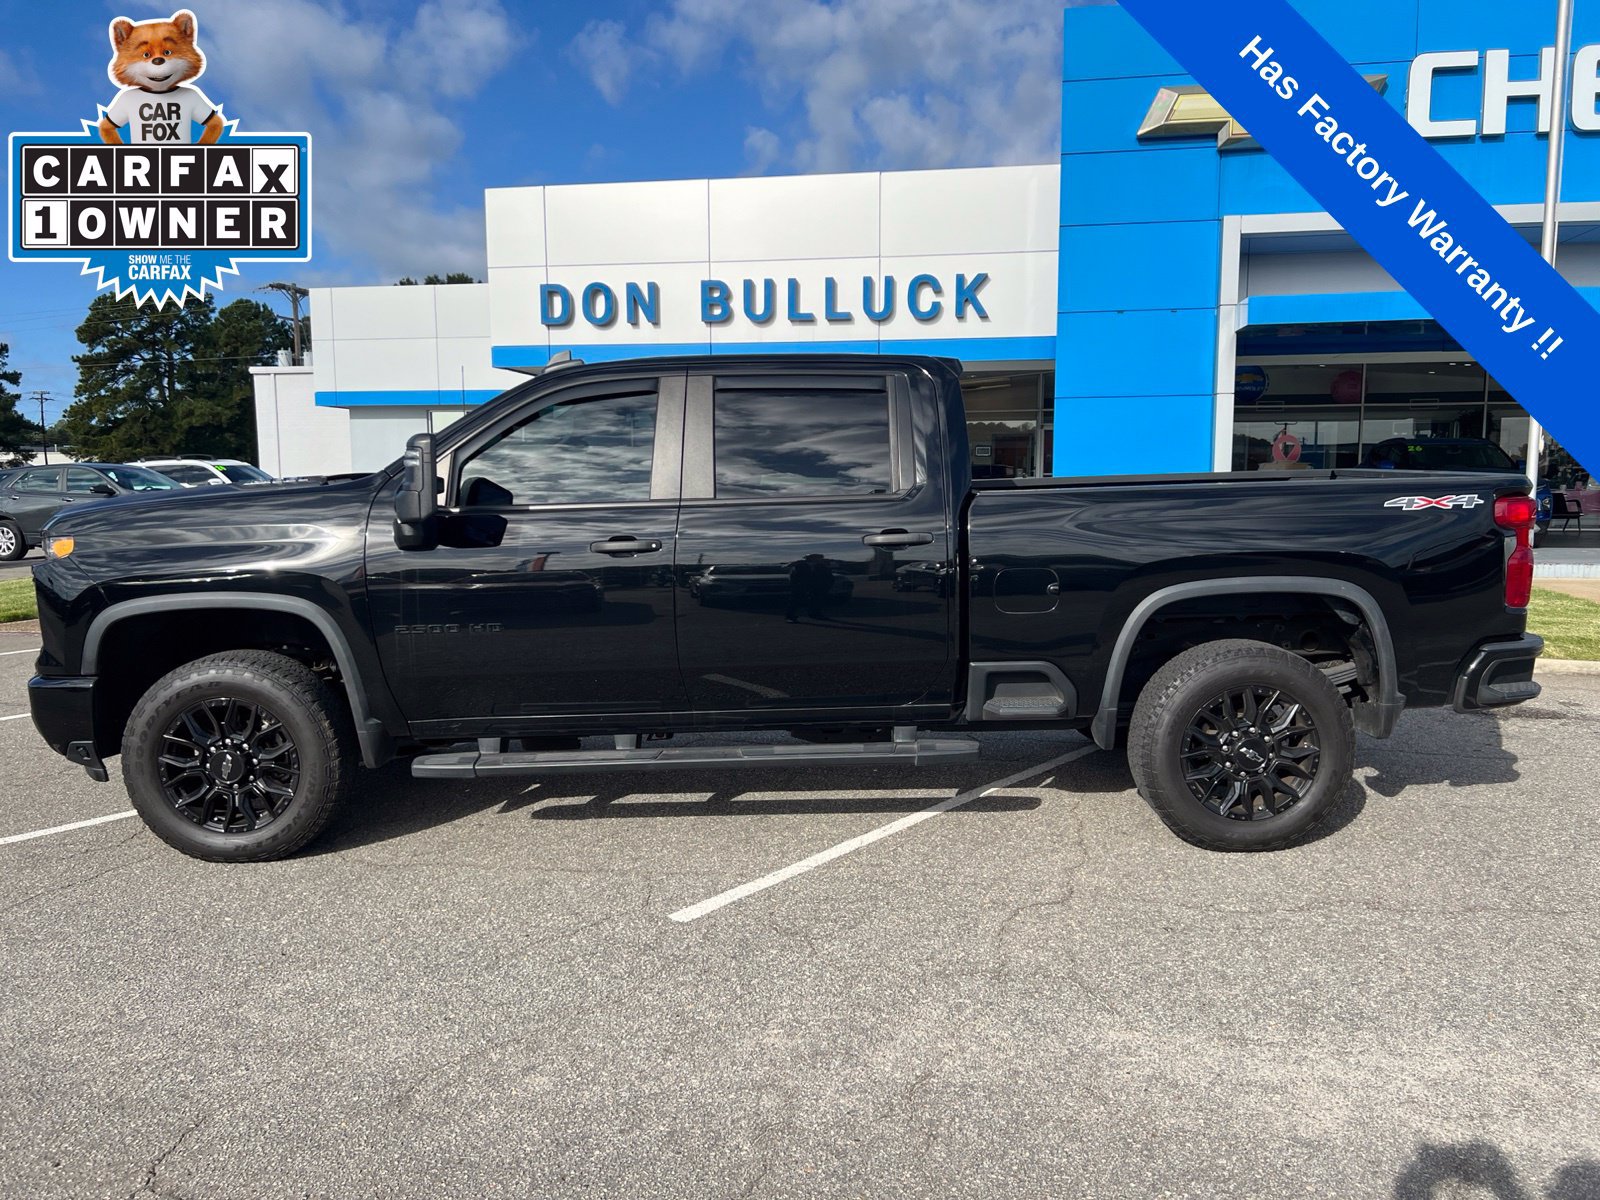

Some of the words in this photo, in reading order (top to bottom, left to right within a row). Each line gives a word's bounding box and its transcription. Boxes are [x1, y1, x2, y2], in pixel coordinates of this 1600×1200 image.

[539, 281, 660, 327] DON
[700, 272, 990, 325] BULLUCK
[394, 623, 461, 634] 2500
[469, 622, 503, 633] HD
